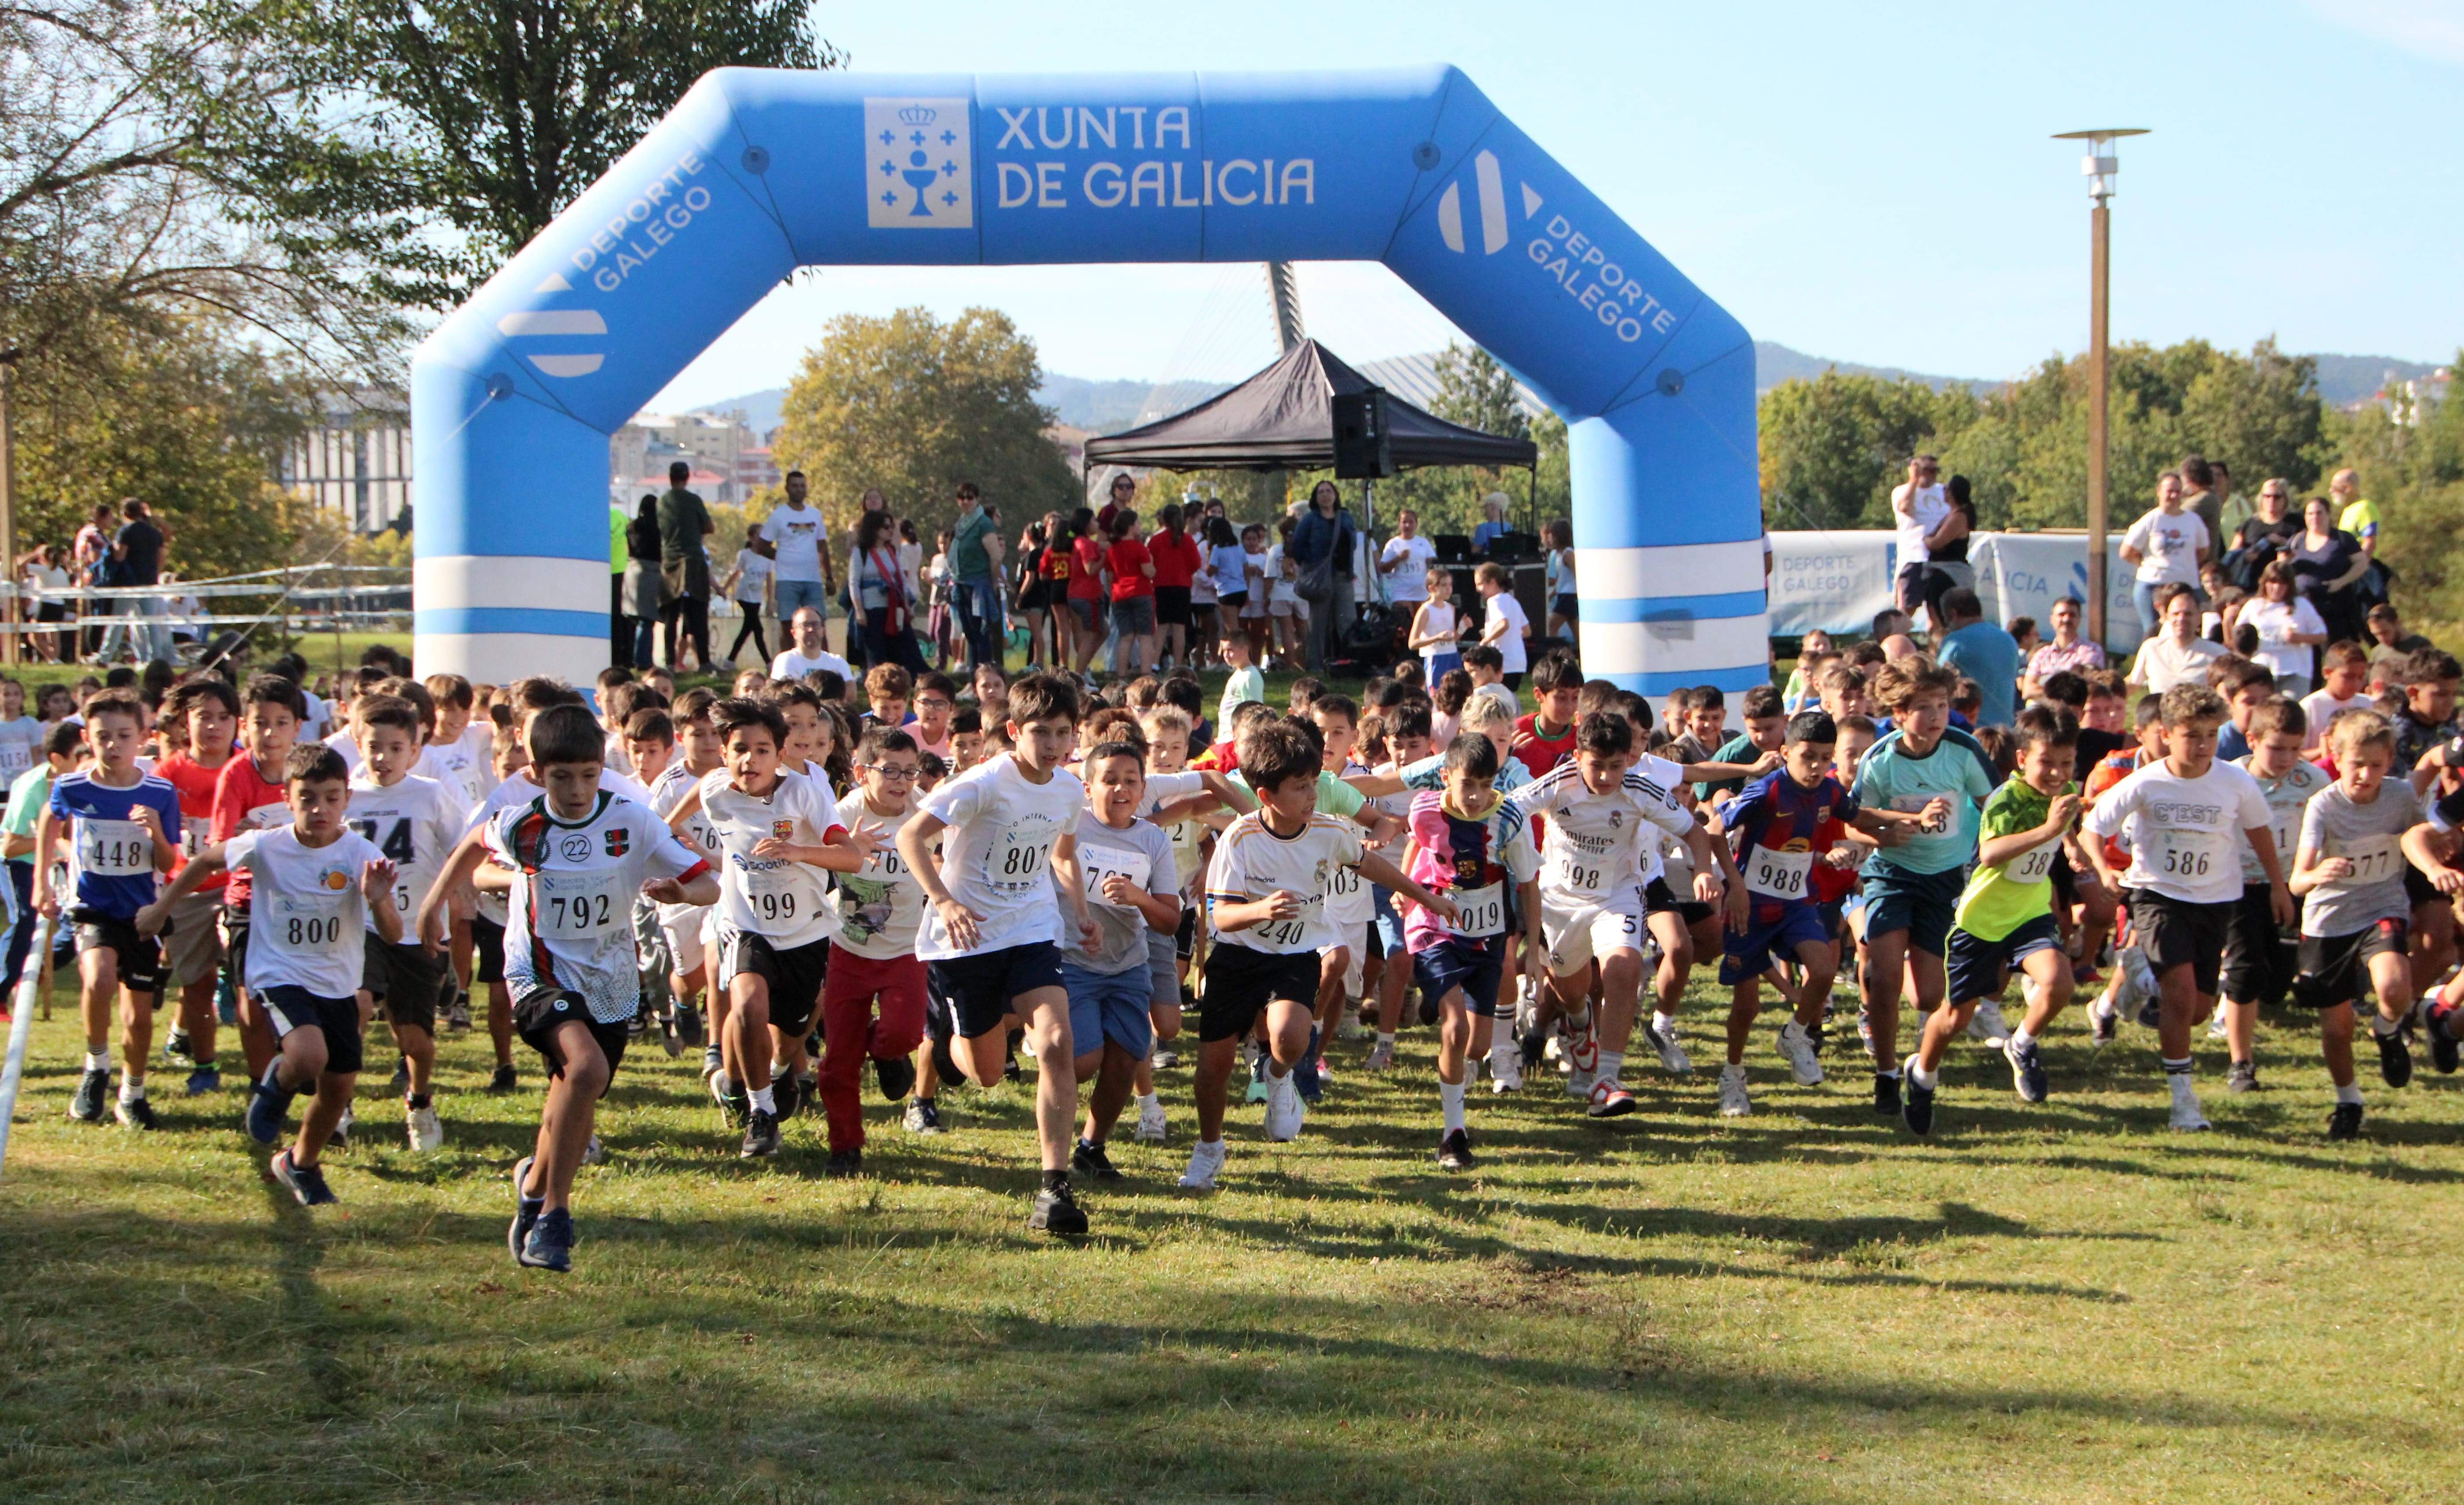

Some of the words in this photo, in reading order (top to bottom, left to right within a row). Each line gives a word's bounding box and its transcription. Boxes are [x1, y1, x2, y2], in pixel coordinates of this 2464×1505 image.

[996, 107, 1191, 149] XUNTA
[997, 162, 1067, 208] DE
[1083, 158, 1315, 207] GALICIA
[572, 150, 705, 272] DEPORTE
[594, 186, 711, 292] GALEGO
[1546, 214, 1676, 334] DEPORTE
[1528, 238, 1642, 343] GALEGO
[1783, 555, 1855, 571] DEPORTE
[1784, 576, 1849, 591] GALEGO
[2154, 803, 2221, 824] C'EST
[565, 839, 588, 856] 22
[693, 827, 723, 850] 76
[93, 840, 141, 867] 448
[1004, 843, 1048, 875] 801
[2165, 849, 2210, 875] 586
[1562, 859, 1599, 889] 998
[1757, 864, 1802, 893] 988
[551, 894, 610, 929] 792
[1622, 915, 1637, 934] 5
[288, 916, 339, 945] 800
